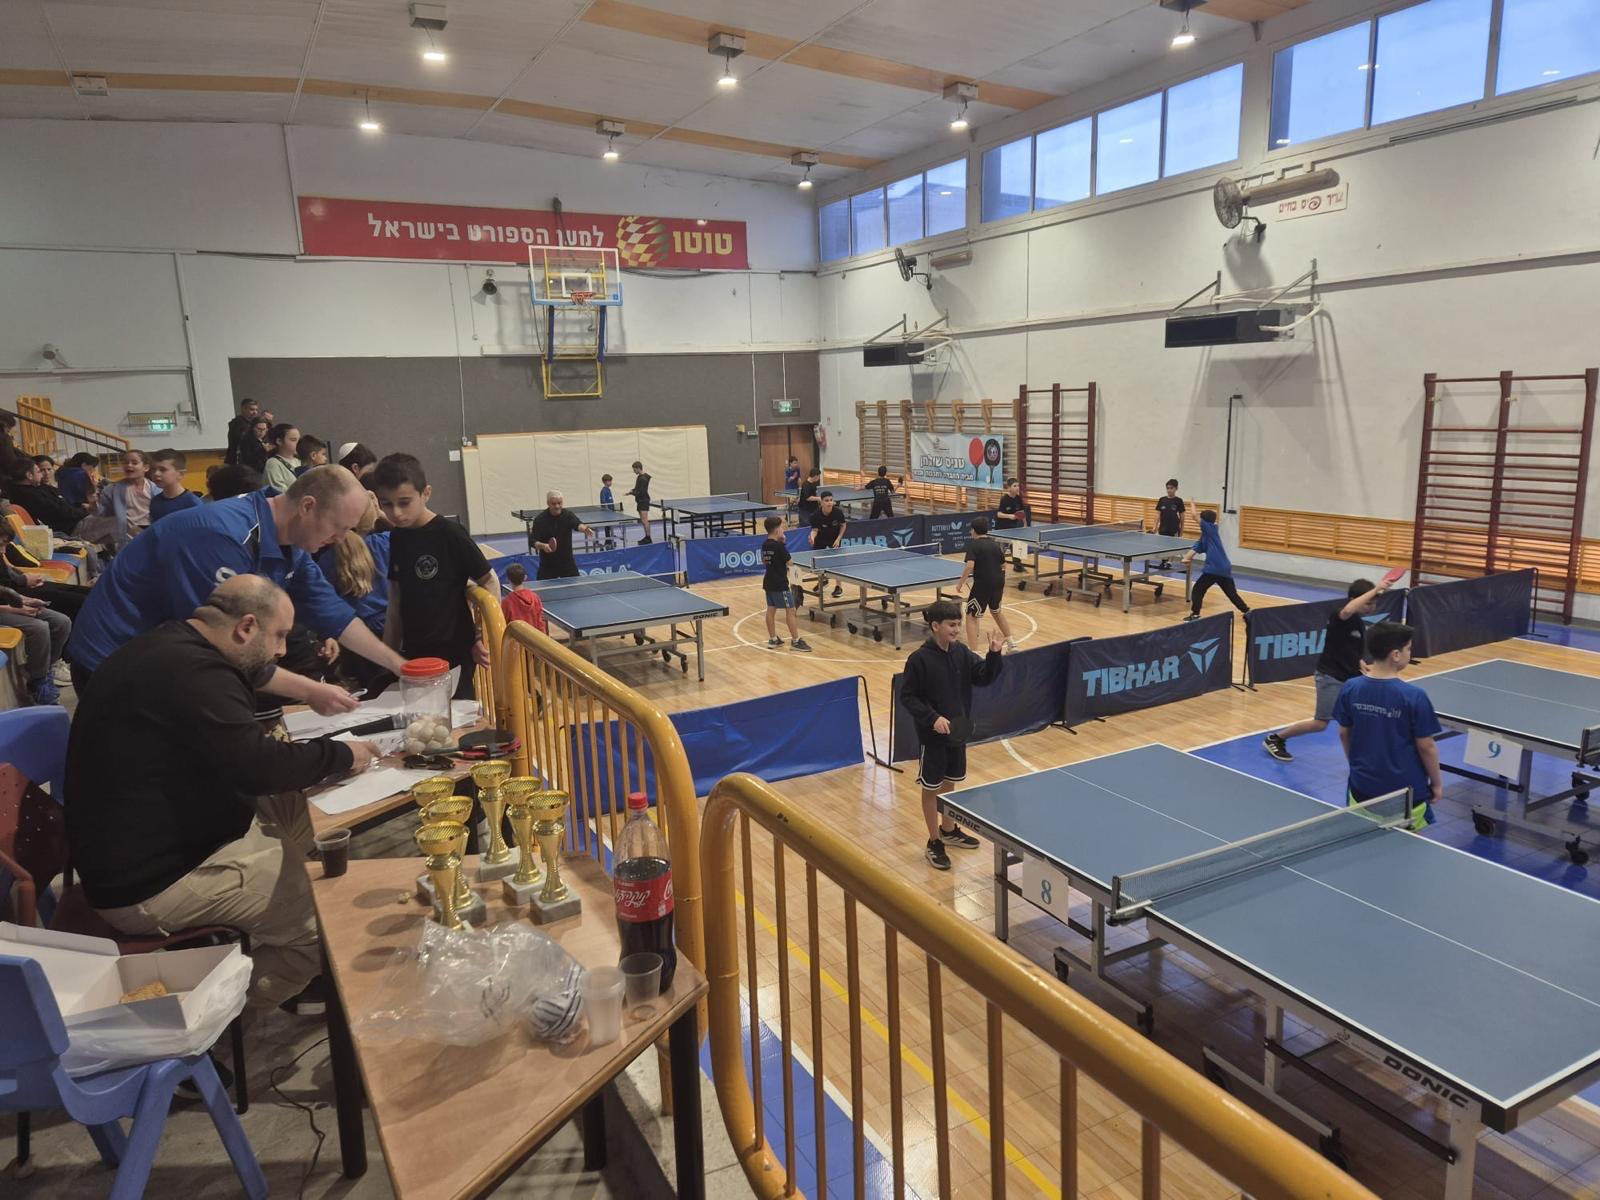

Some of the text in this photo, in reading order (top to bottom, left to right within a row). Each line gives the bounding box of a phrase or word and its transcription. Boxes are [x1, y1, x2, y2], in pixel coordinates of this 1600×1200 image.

[367, 212, 604, 248] למען הספורט בישראל
[672, 231, 733, 255] טוטו
[920, 453, 965, 469] טניס שולחן
[719, 549, 764, 568] JOOL
[1255, 629, 1327, 661] TIBH
[1083, 655, 1180, 697] TIBHAR
[1488, 741, 1501, 758] 9
[948, 810, 980, 833] DONIC
[1041, 879, 1051, 904] 8
[1383, 1055, 1469, 1108] DONIC
